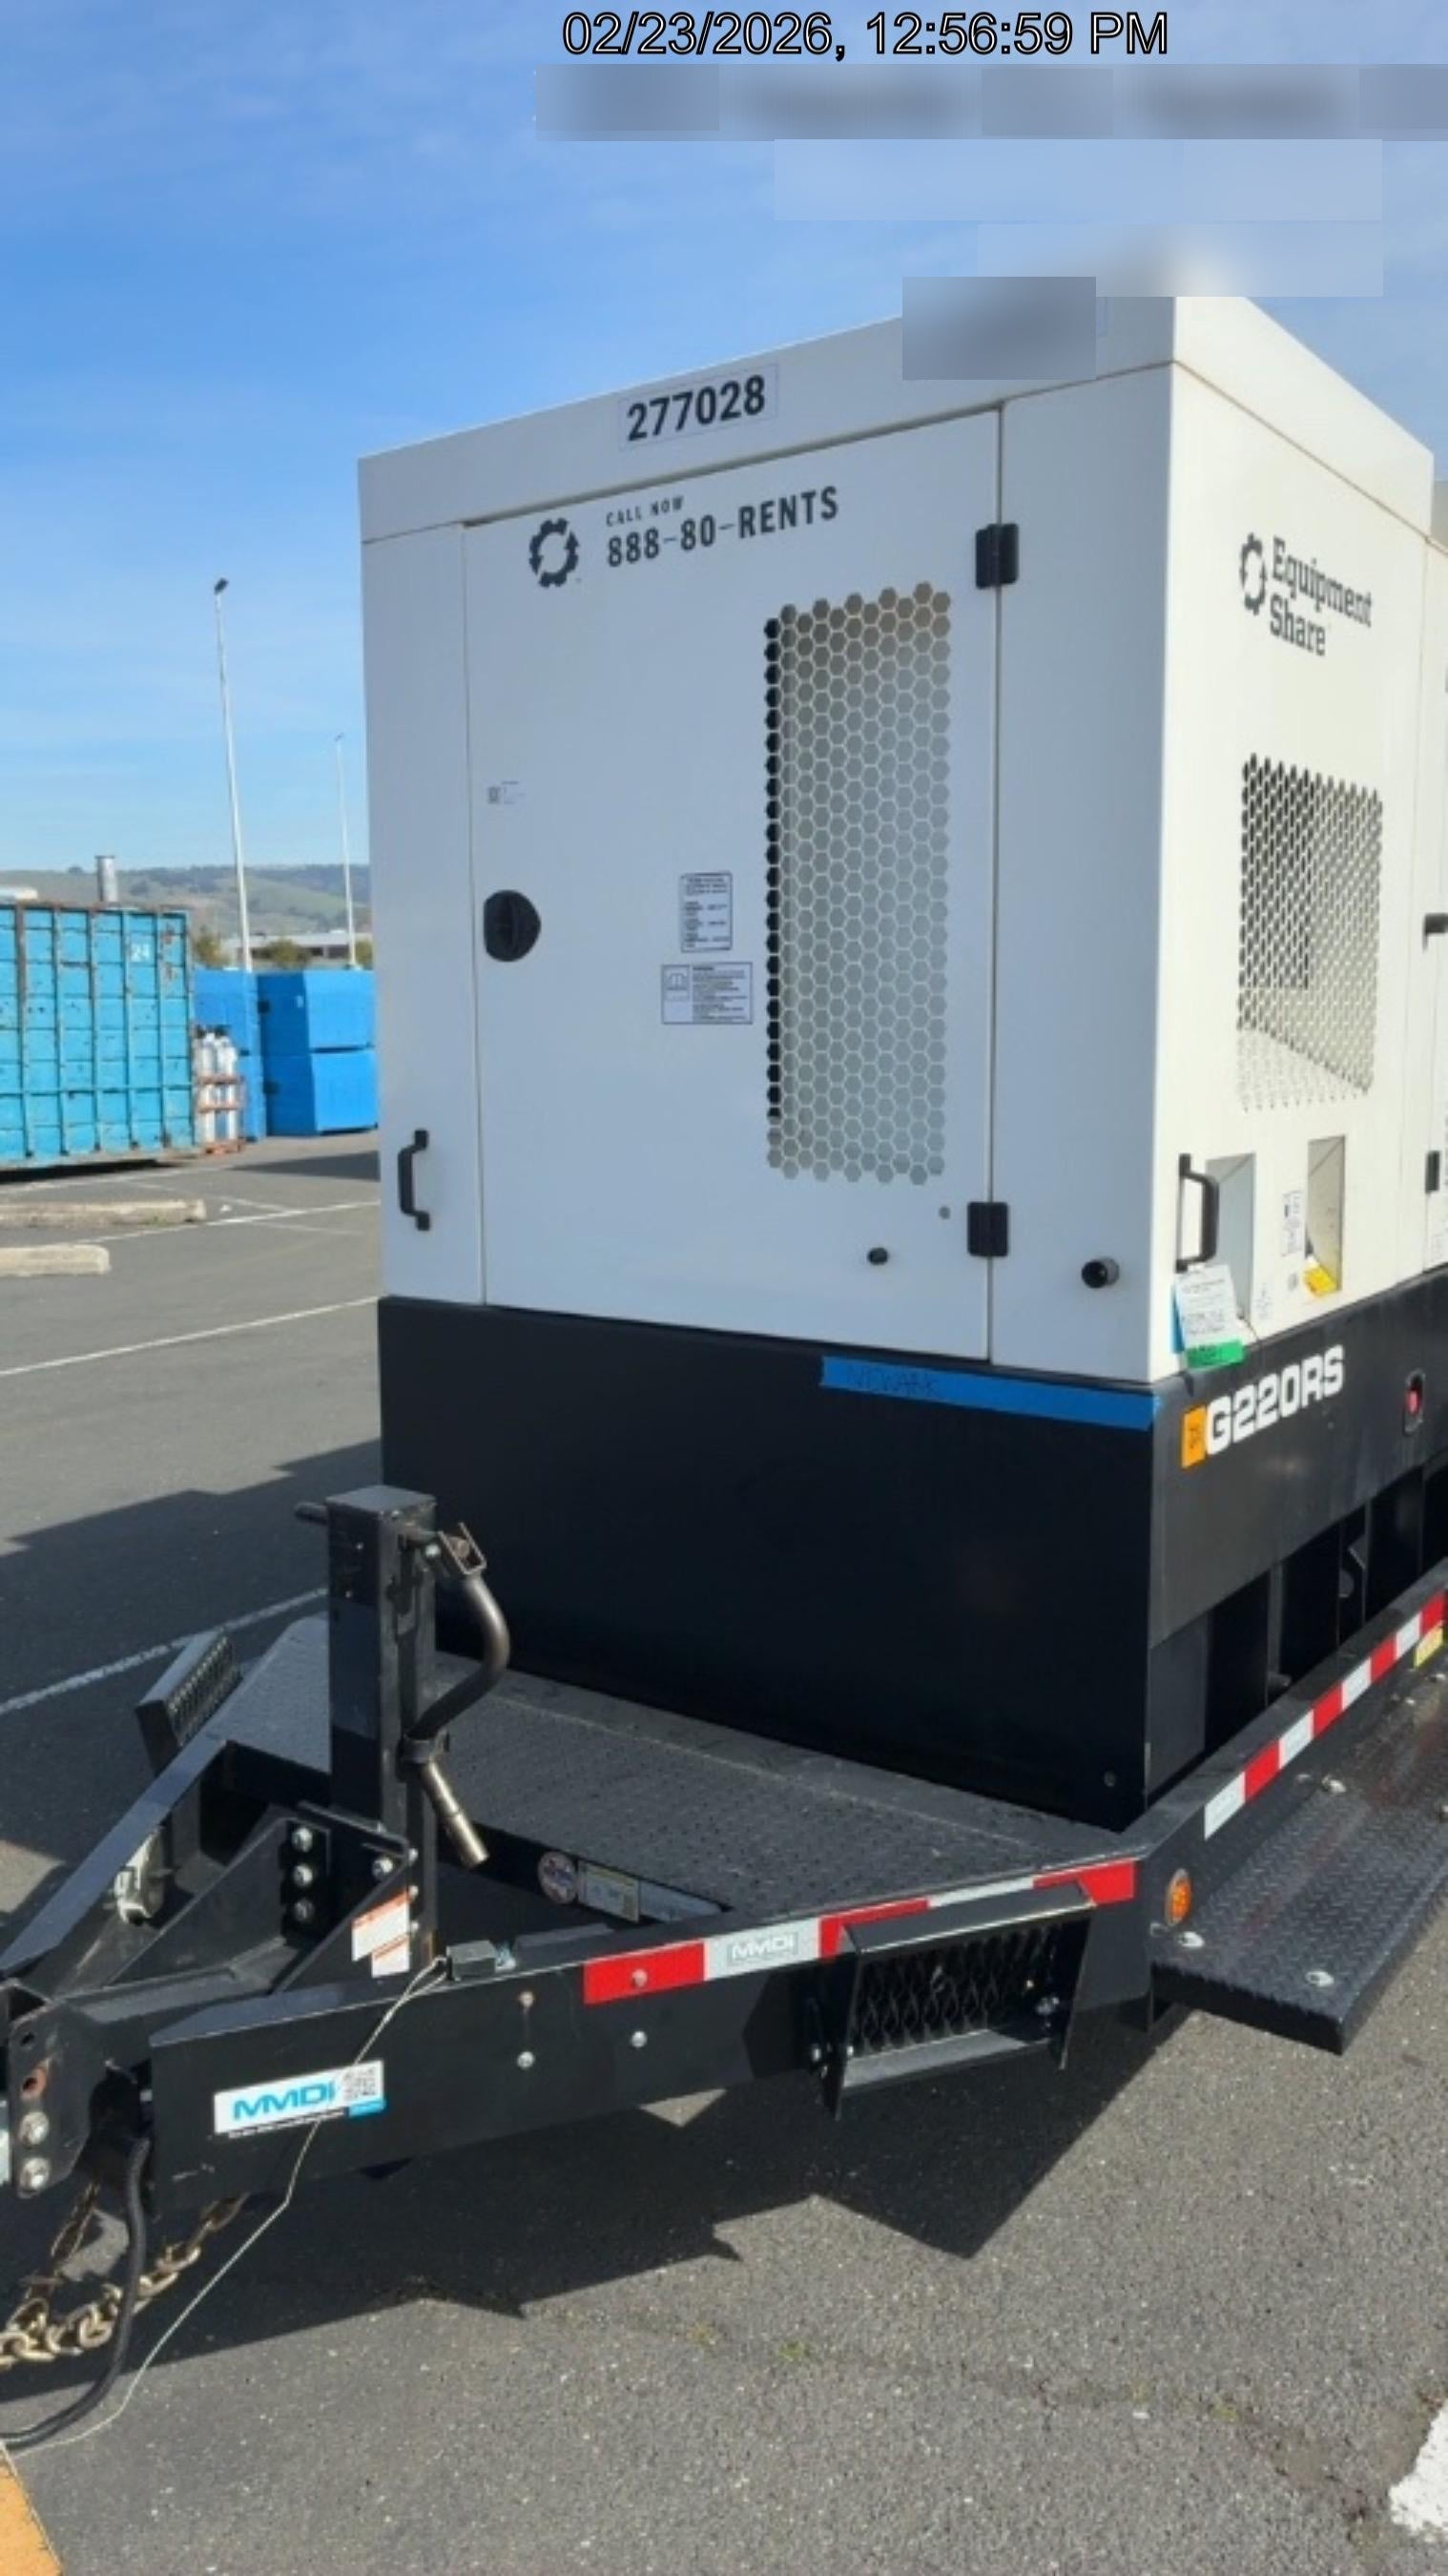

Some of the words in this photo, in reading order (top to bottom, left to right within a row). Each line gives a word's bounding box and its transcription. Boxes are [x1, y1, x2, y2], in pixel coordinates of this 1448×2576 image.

[627, 374, 765, 442] 277028
[606, 506, 642, 527] CALL
[651, 495, 684, 516] NOW
[608, 486, 839, 568] 888-80-RENTS
[1272, 534, 1372, 628] Equipment
[1270, 592, 1325, 656] Share
[1205, 1344, 1344, 1455] G220RS
